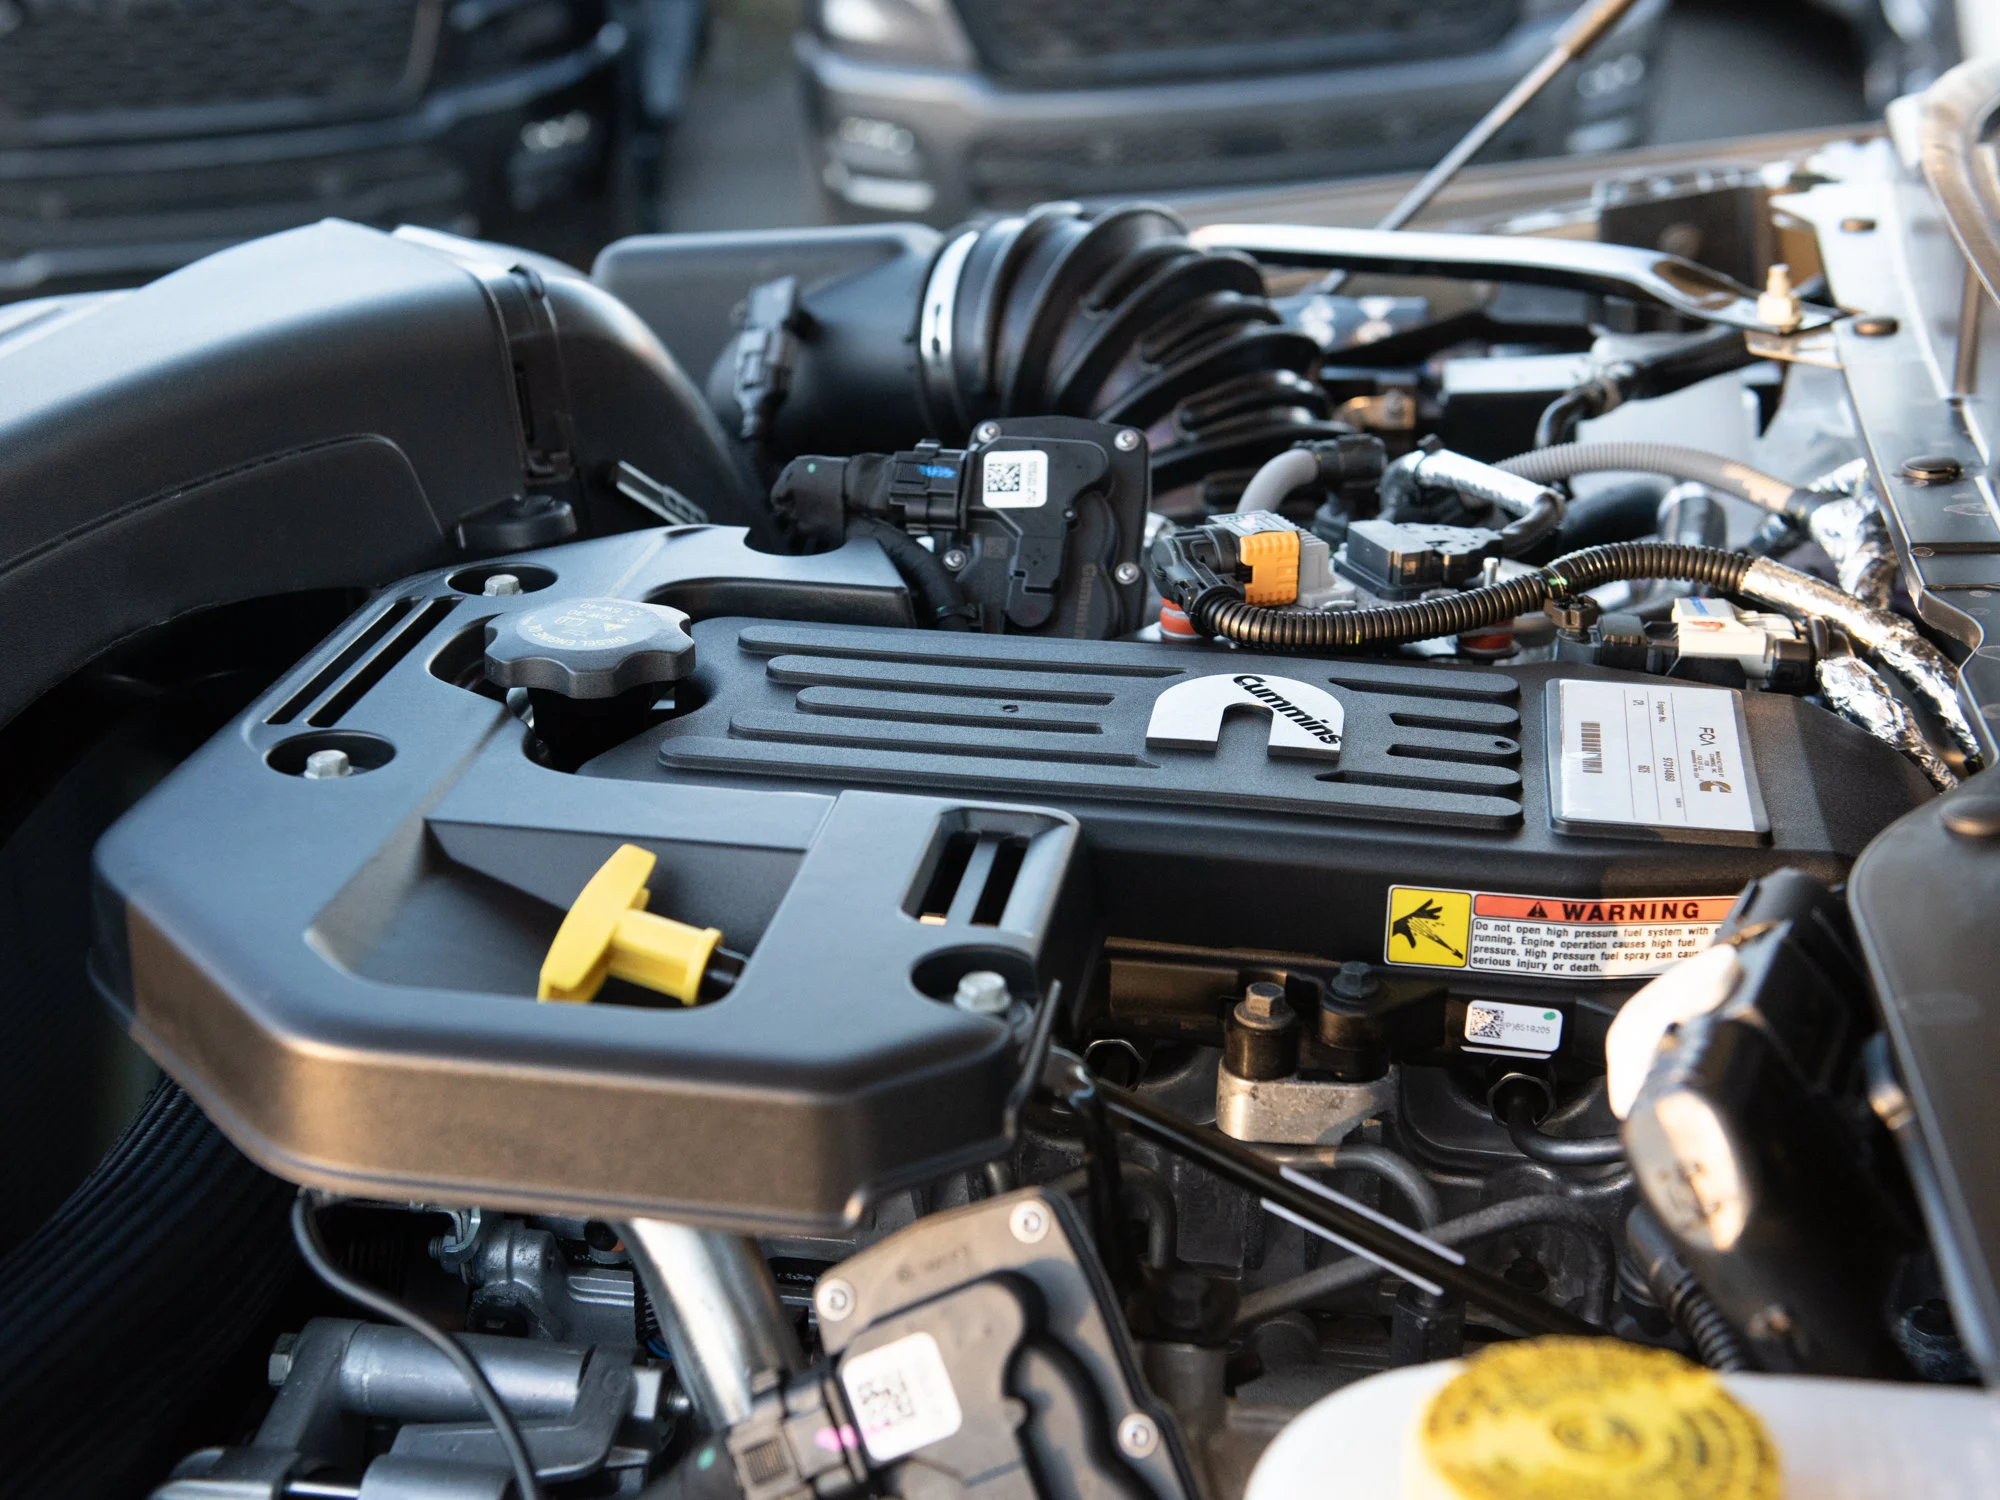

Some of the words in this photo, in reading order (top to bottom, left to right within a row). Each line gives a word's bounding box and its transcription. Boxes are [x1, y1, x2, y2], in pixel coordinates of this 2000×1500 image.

[1073, 563, 1098, 639] Cummin
[583, 635, 628, 647] DIESEL
[1233, 674, 1342, 745] Cummins
[1656, 701, 1665, 715] Engine
[1698, 727, 1717, 746] FCA
[1562, 902, 1699, 921] WARNING
[1475, 921, 1488, 931] Do
[1494, 924, 1511, 933] not
[1516, 926, 1541, 936] open
[1547, 927, 1569, 939] high
[1574, 929, 1618, 939] pressure
[1624, 928, 1642, 937] fuel
[1648, 928, 1682, 939] system
[1688, 927, 1709, 936] with
[1474, 933, 1516, 946] running.
[1521, 937, 1555, 949] Engine
[1560, 941, 1607, 951] operation
[1612, 940, 1646, 949] causes
[1651, 938, 1672, 950] high
[1678, 938, 1696, 947] fuel
[1473, 945, 1519, 956] pressure.
[1525, 948, 1547, 960] High
[1552, 951, 1596, 961] pressure
[1601, 952, 1619, 961] fuel
[1624, 951, 1650, 962] spray
[1655, 951, 1673, 959] can
[1472, 957, 1511, 967] serious
[1517, 959, 1547, 971] injury
[1553, 963, 1564, 971] or
[1570, 963, 1602, 973] death.
